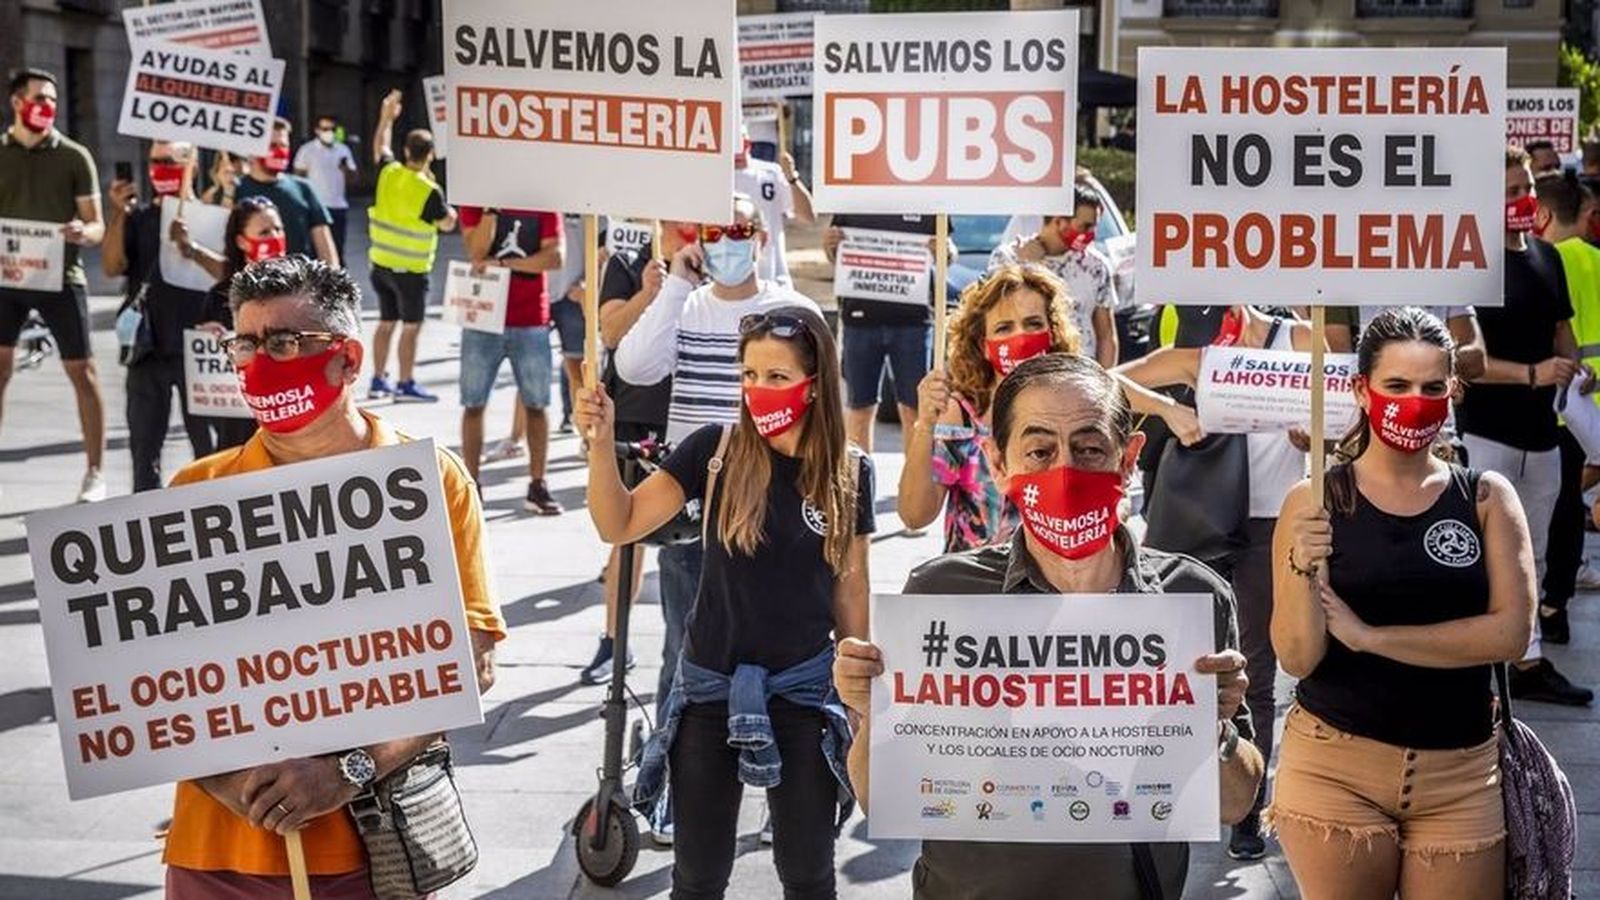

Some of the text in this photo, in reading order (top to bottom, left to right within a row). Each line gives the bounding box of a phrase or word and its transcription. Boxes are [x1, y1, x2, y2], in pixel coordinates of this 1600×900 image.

[141, 51, 273, 88] AYUDAS AL
[455, 24, 723, 79] SALVEMOS LA
[824, 38, 1066, 73] SALVEMOS LOS
[137, 76, 269, 111] ALQUILER DE
[1155, 65, 1490, 115] LA HOSTELERÍA
[1548, 99, 1575, 112] LOS
[131, 97, 265, 138] LOCALES
[459, 90, 721, 152] HOSTELERÍA
[833, 95, 1055, 183] PUBS
[1550, 119, 1571, 135] DE
[1191, 133, 1452, 187] NO ES EL
[761, 182, 775, 202] G
[1153, 212, 1488, 269] PROBLEMA
[50, 466, 429, 584] QUEREMOS
[1024, 507, 1110, 532] SALVEMOSLA
[67, 535, 433, 648] TRABAJAR
[922, 620, 1166, 669] #SALVEMOS
[72, 618, 453, 719] EL OCIO NOCTURNO
[893, 663, 1196, 708] LAHOSTELERÍA
[78, 662, 464, 763] NO ES EL CULPABLE
[893, 722, 1194, 740] CONCENTRACIÓN EN APOYO A LA HOSTELERÍA
[926, 743, 1165, 758] Y LOS LOCALES DE OCIO NOCTURNO
